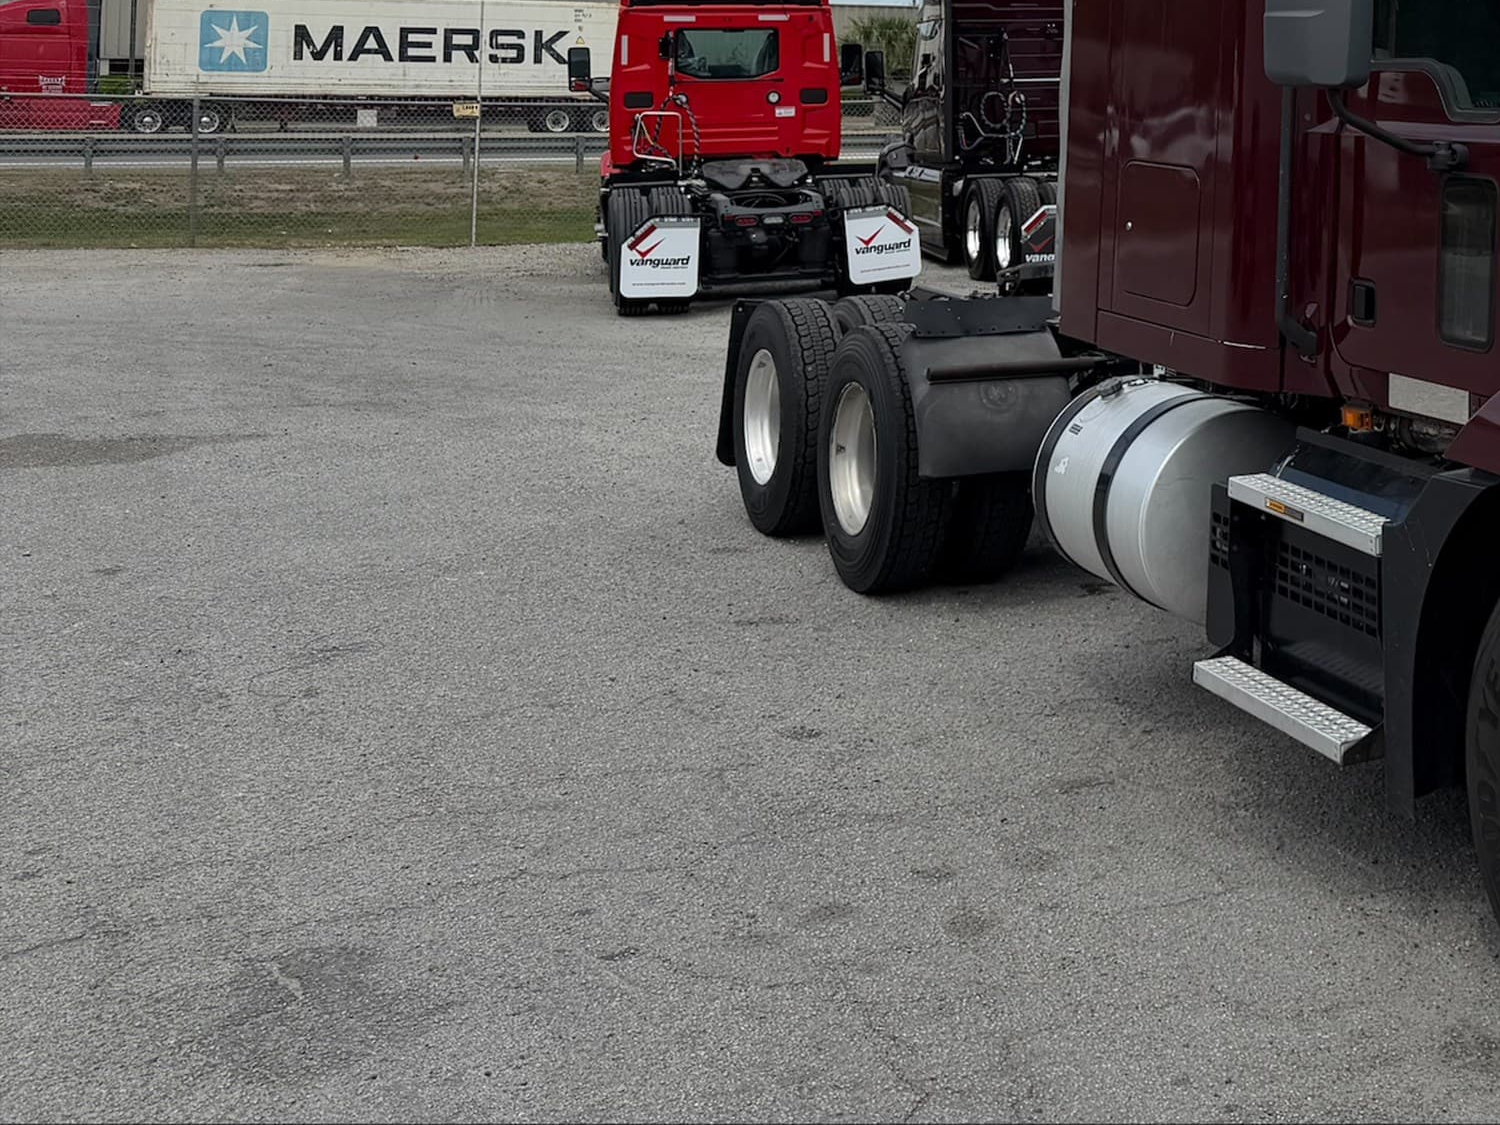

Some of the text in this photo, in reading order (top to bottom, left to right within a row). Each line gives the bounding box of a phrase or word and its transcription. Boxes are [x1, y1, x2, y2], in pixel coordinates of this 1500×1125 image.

[293, 23, 571, 65] MAERSK
[855, 238, 911, 255] vanguard
[629, 255, 691, 269] vanguard
